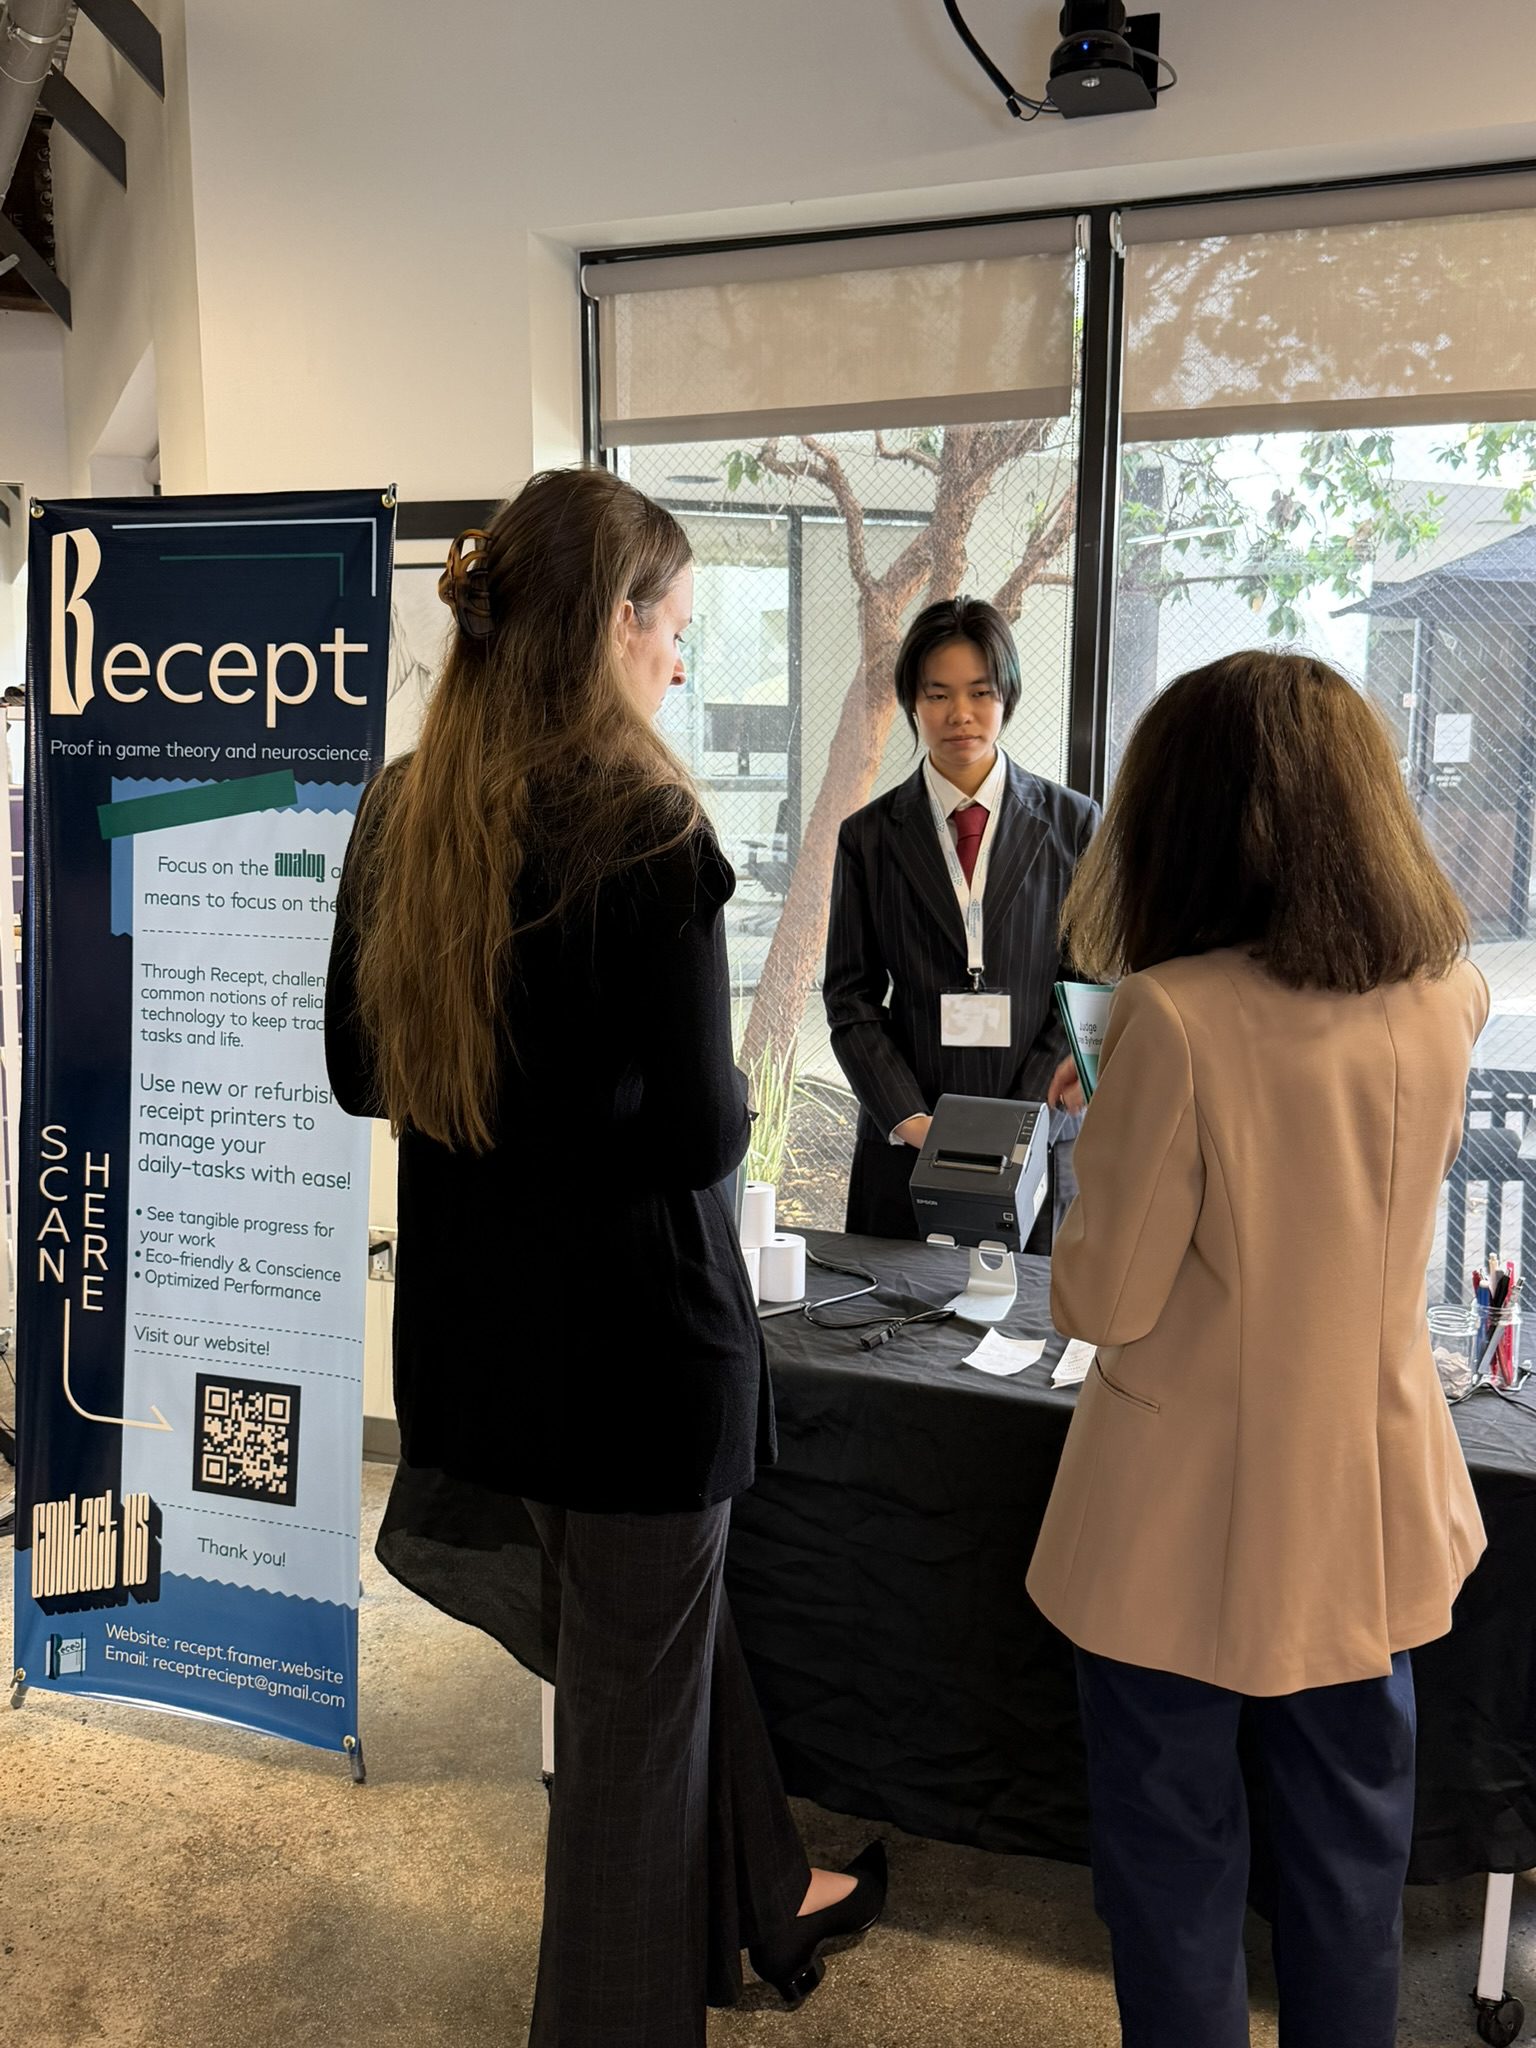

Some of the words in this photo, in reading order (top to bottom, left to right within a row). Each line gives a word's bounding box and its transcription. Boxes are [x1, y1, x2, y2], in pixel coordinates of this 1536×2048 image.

[50, 527, 369, 729] Recept
[50, 740, 93, 756] Proof
[98, 741, 111, 756] in
[117, 744, 160, 760] game
[165, 742, 220, 761] theory
[226, 744, 256, 759] and
[262, 745, 371, 761] neuroscience.
[159, 856, 207, 874] Focus
[213, 863, 233, 874] on
[240, 859, 269, 875] the
[275, 849, 325, 882] analog
[144, 893, 200, 906] means
[206, 893, 225, 907] to
[231, 892, 276, 910] focus
[282, 898, 302, 911] on
[141, 963, 205, 984] Through
[211, 967, 267, 987] Recept,
[272, 970, 325, 987] challen
[141, 988, 205, 1002] common
[210, 991, 266, 1006] notions
[271, 992, 287, 1007] of
[293, 994, 324, 1009] relia
[141, 1007, 225, 1027] technology
[230, 1012, 247, 1026] to
[252, 1012, 287, 1031] keep
[292, 1017, 325, 1030] trac
[141, 1028, 182, 1043] tasks
[187, 1031, 215, 1045] and
[221, 1032, 243, 1047] life.
[141, 1073, 175, 1092] Use
[182, 1080, 222, 1096] new
[228, 1084, 248, 1098] or
[255, 1082, 334, 1104] refurbis
[140, 1103, 204, 1125] receipt
[211, 1107, 286, 1128] printers
[293, 1113, 315, 1131] to
[140, 1131, 215, 1153] manage
[222, 1138, 266, 1155] your
[252, 1166, 295, 1184] with
[302, 1172, 351, 1190] ease!
[37, 1125, 70, 1283] SCAN
[83, 1152, 110, 1311] HERE
[147, 1206, 174, 1222] See
[179, 1210, 239, 1229] tangible
[244, 1218, 308, 1235] progress
[314, 1221, 335, 1237] for
[140, 1230, 174, 1244] your
[179, 1233, 215, 1247] work
[146, 1248, 233, 1273] Eco-friendly
[239, 1258, 251, 1272] &
[256, 1260, 341, 1281] Conscience
[145, 1269, 219, 1290] Optimized
[224, 1278, 321, 1301] Performance
[134, 1325, 169, 1343] Visit
[174, 1333, 199, 1347] our
[204, 1336, 270, 1355] website!
[198, 1537, 248, 1560] Thank
[253, 1550, 286, 1567] you!
[106, 1623, 169, 1649] Website:
[174, 1639, 343, 1684] recept.framer.website
[106, 1645, 148, 1667] Email:
[153, 1656, 345, 1708] receptreciept@gmail.com
